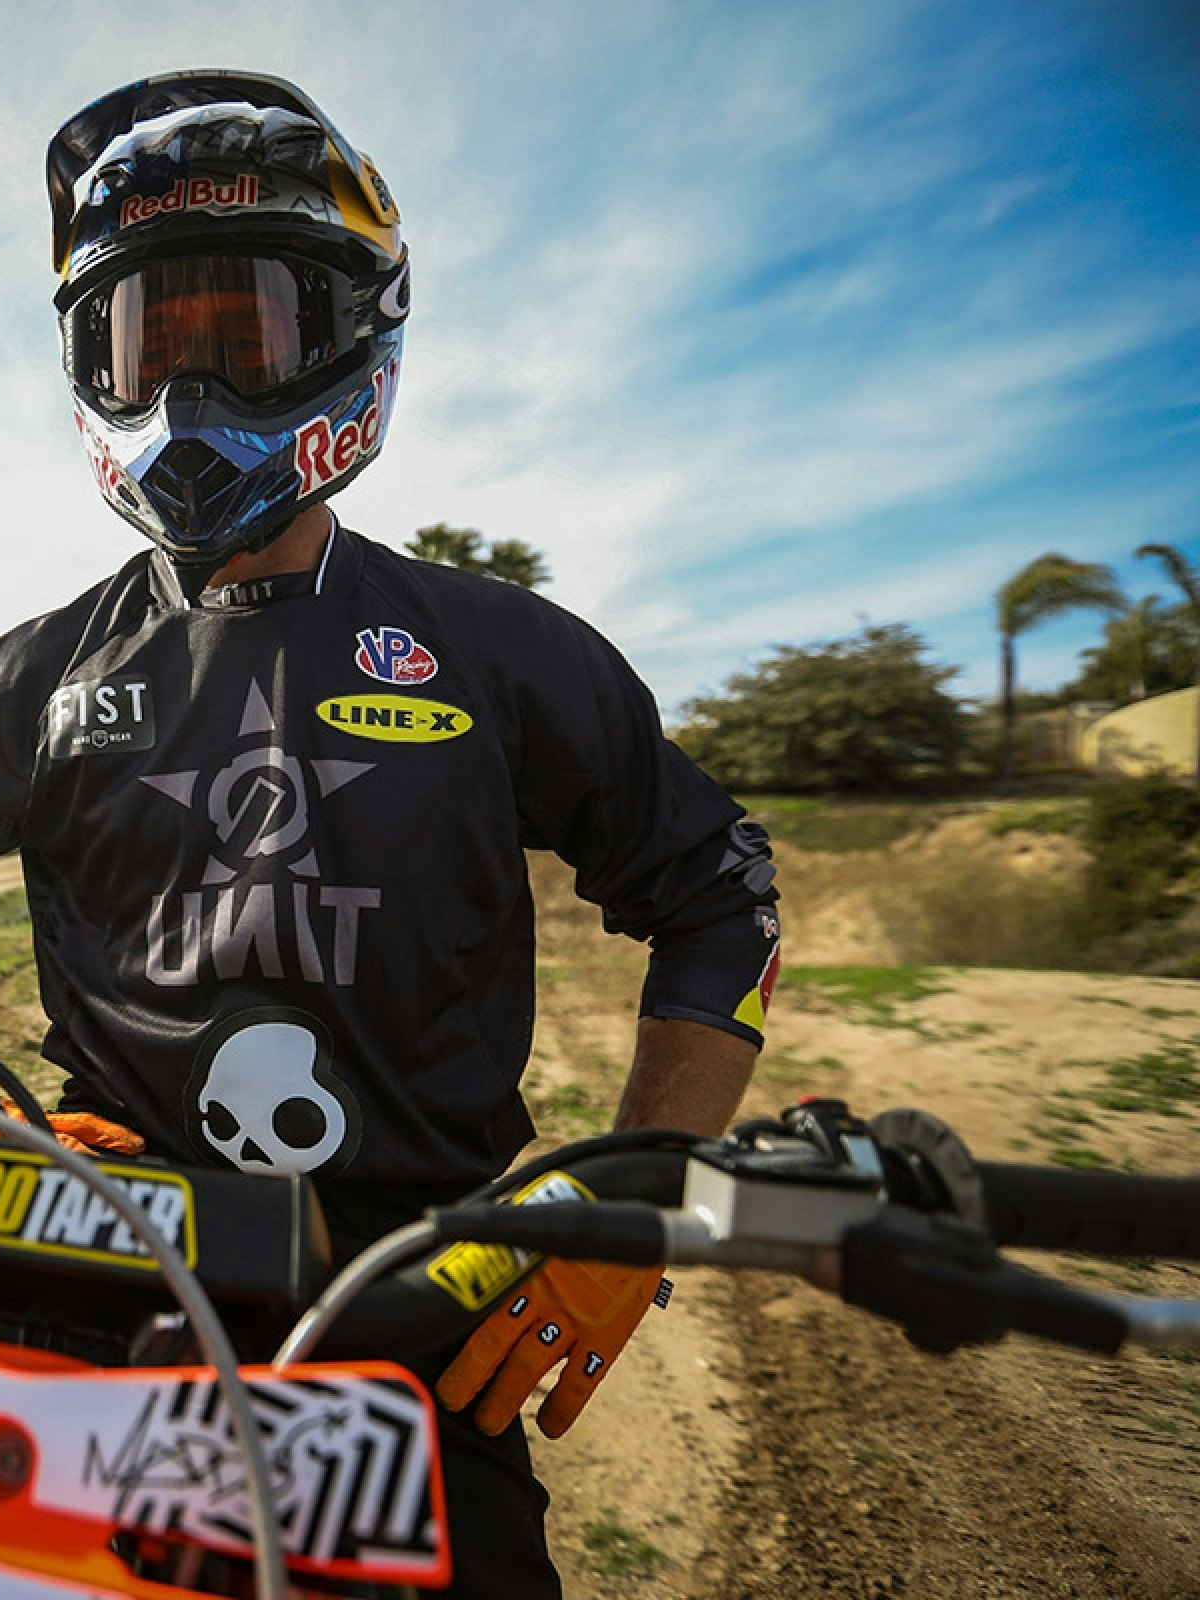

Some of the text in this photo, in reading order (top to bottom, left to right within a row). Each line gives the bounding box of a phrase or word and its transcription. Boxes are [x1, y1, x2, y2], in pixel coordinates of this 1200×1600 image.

[121, 174, 258, 229] Red Bull
[295, 367, 384, 500] Red
[357, 628, 413, 681] VP
[54, 683, 146, 730] FIST
[329, 703, 457, 731] LINE-X
[146, 884, 381, 987] UNIT
